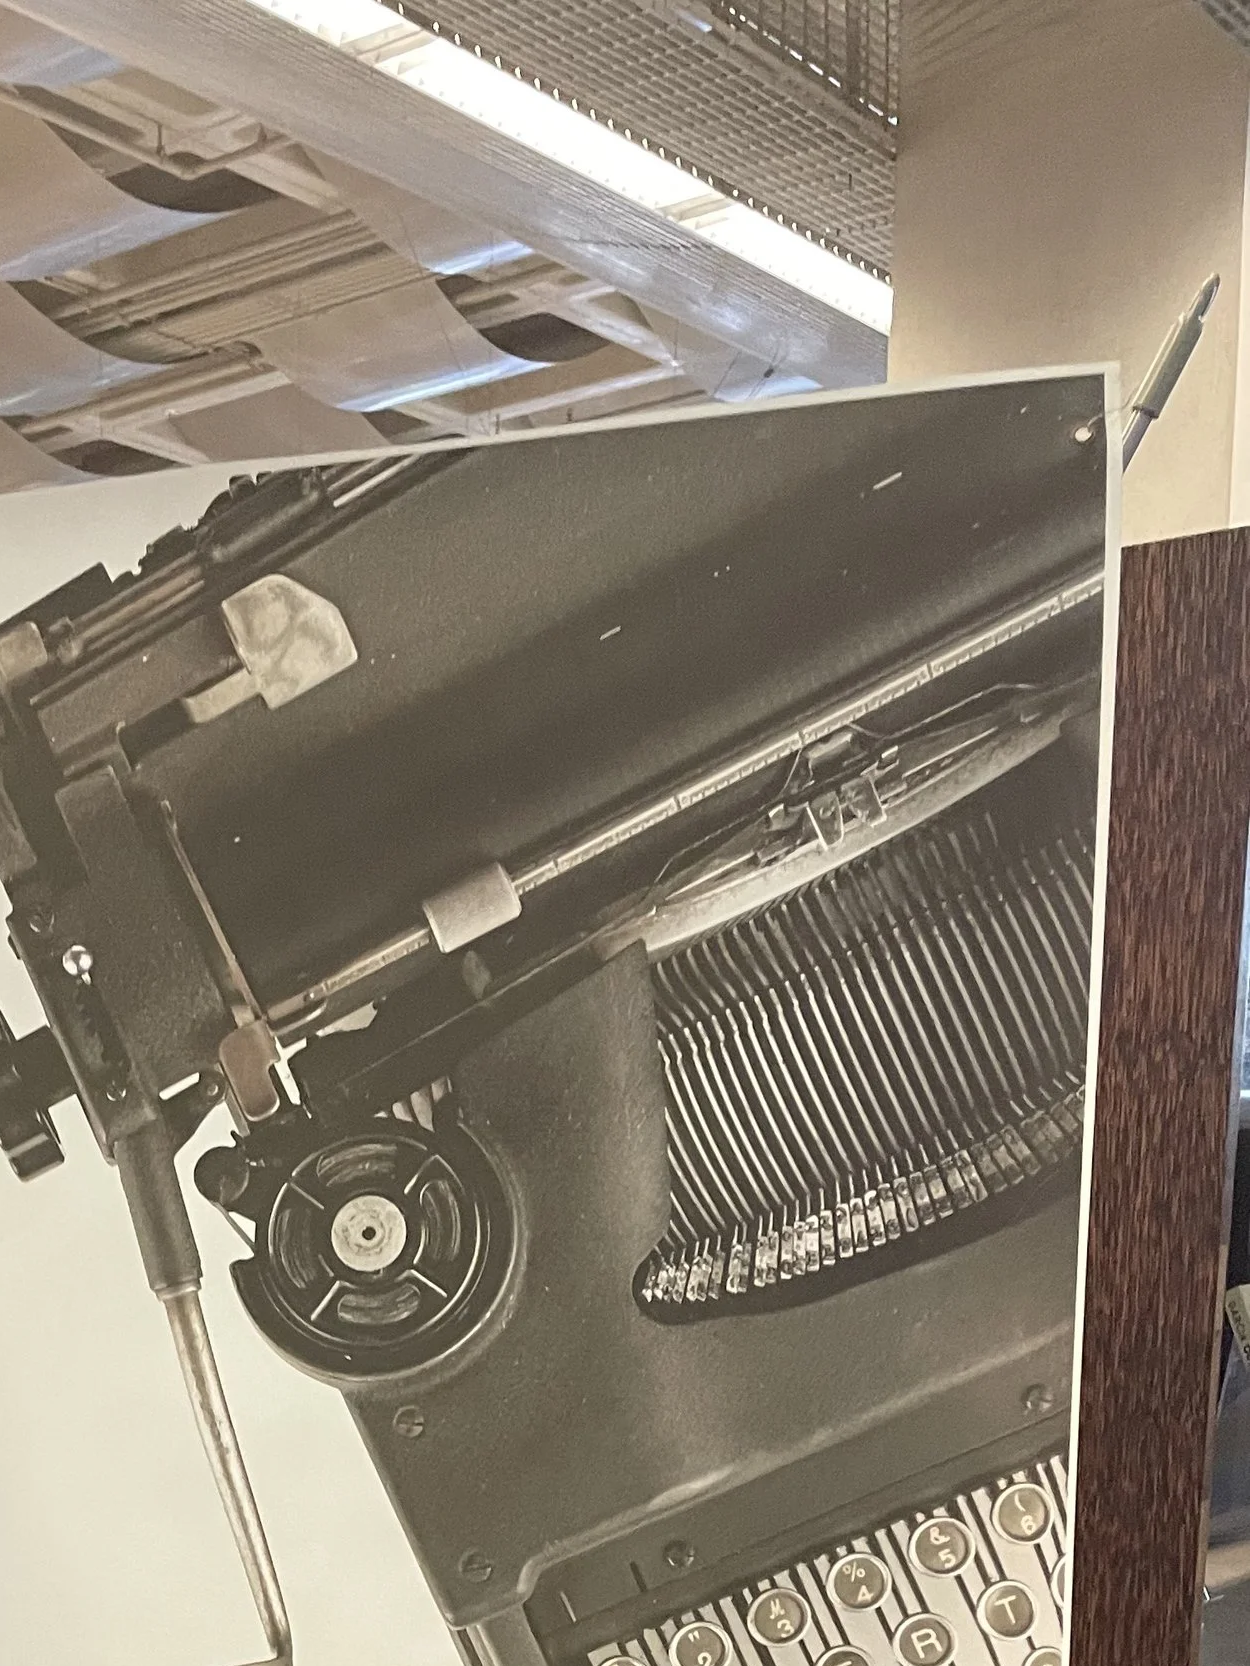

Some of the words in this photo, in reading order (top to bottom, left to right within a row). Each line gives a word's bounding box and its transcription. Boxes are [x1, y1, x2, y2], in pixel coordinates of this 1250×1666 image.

[1020, 1515, 1035, 1536] 6
[938, 1549, 956, 1570] 5
[856, 1584, 875, 1603] 4
[777, 1619, 795, 1638] 3
[910, 1628, 943, 1660] R
[993, 1595, 1017, 1625] T
